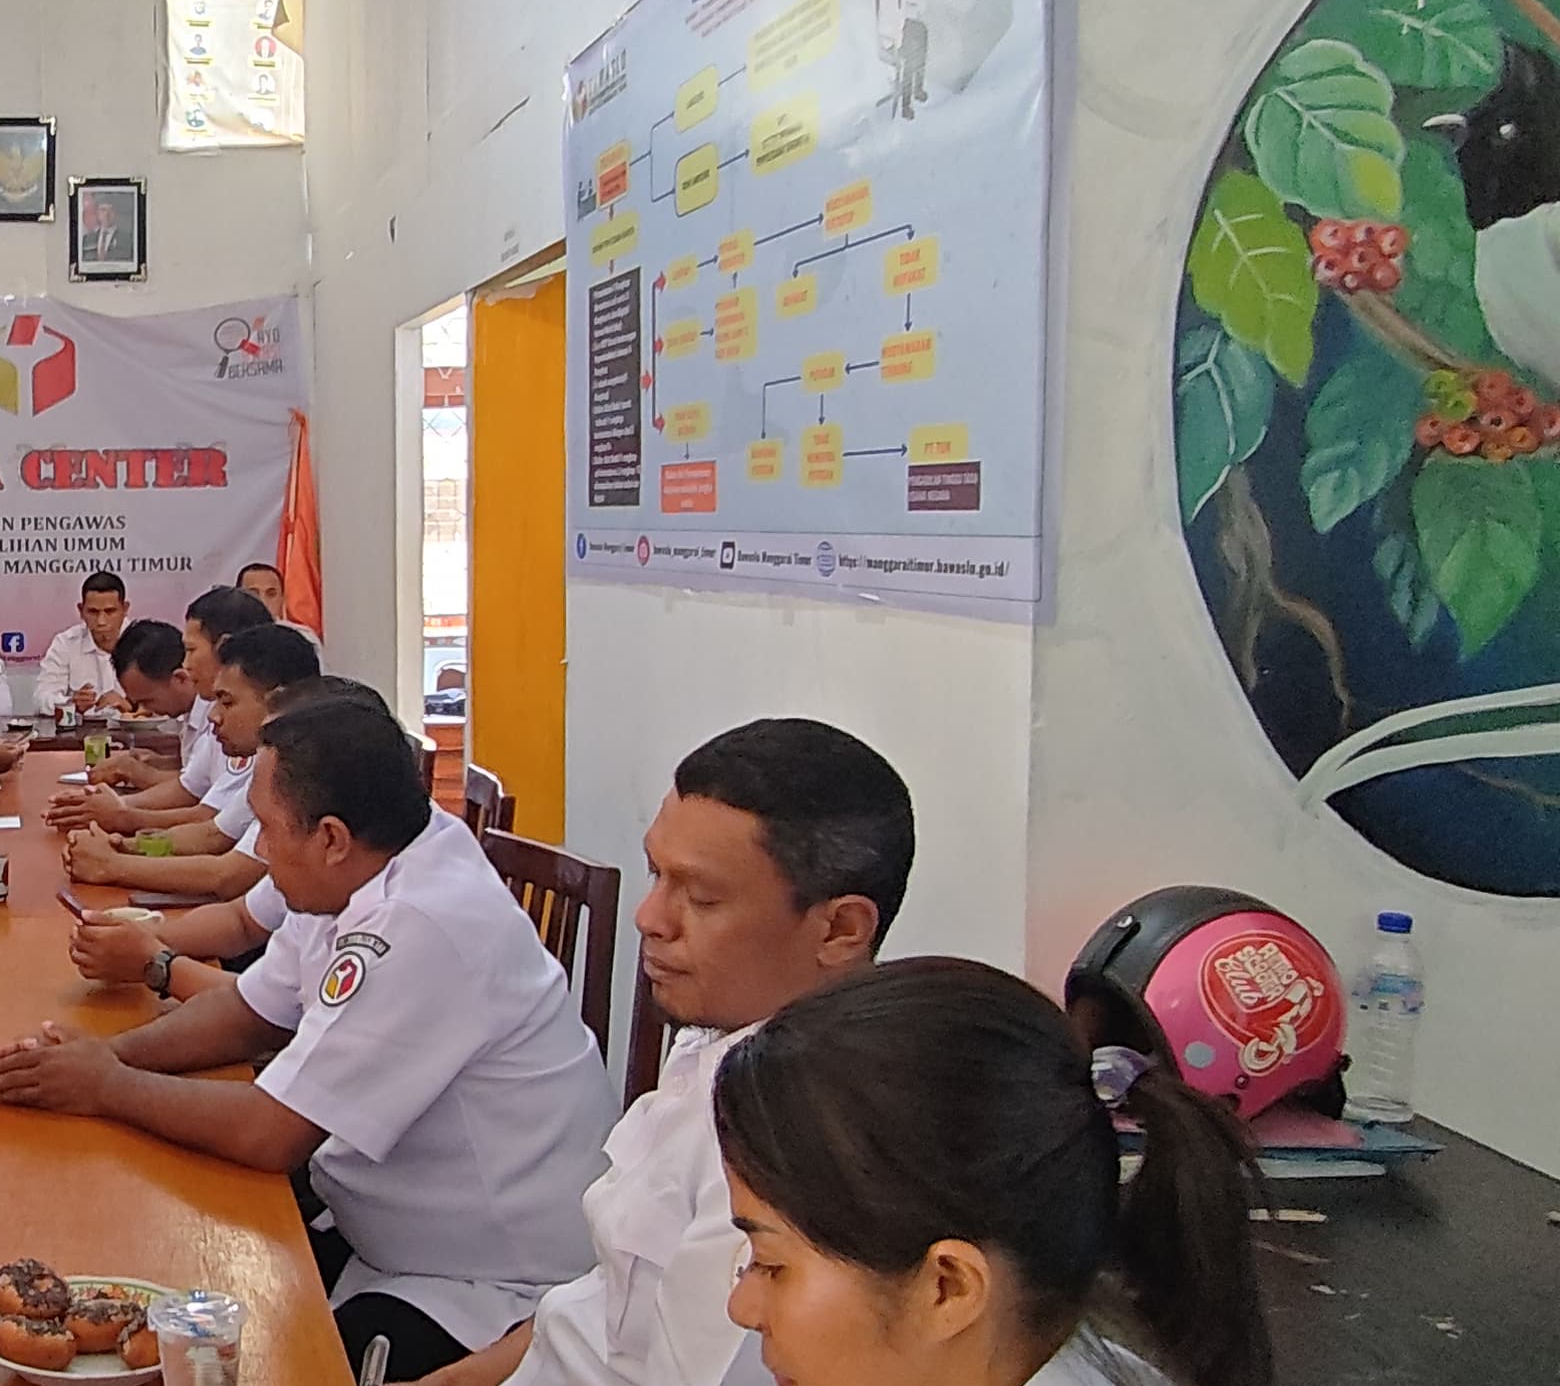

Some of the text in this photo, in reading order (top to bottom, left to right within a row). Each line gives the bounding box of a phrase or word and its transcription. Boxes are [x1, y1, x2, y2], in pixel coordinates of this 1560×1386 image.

[20, 448, 228, 490] CENTER
[20, 514, 127, 531] PENGAWAS
[63, 536, 126, 552] UMUM
[3, 558, 123, 574] MANGGARAI
[126, 556, 193, 573] TIMUR
